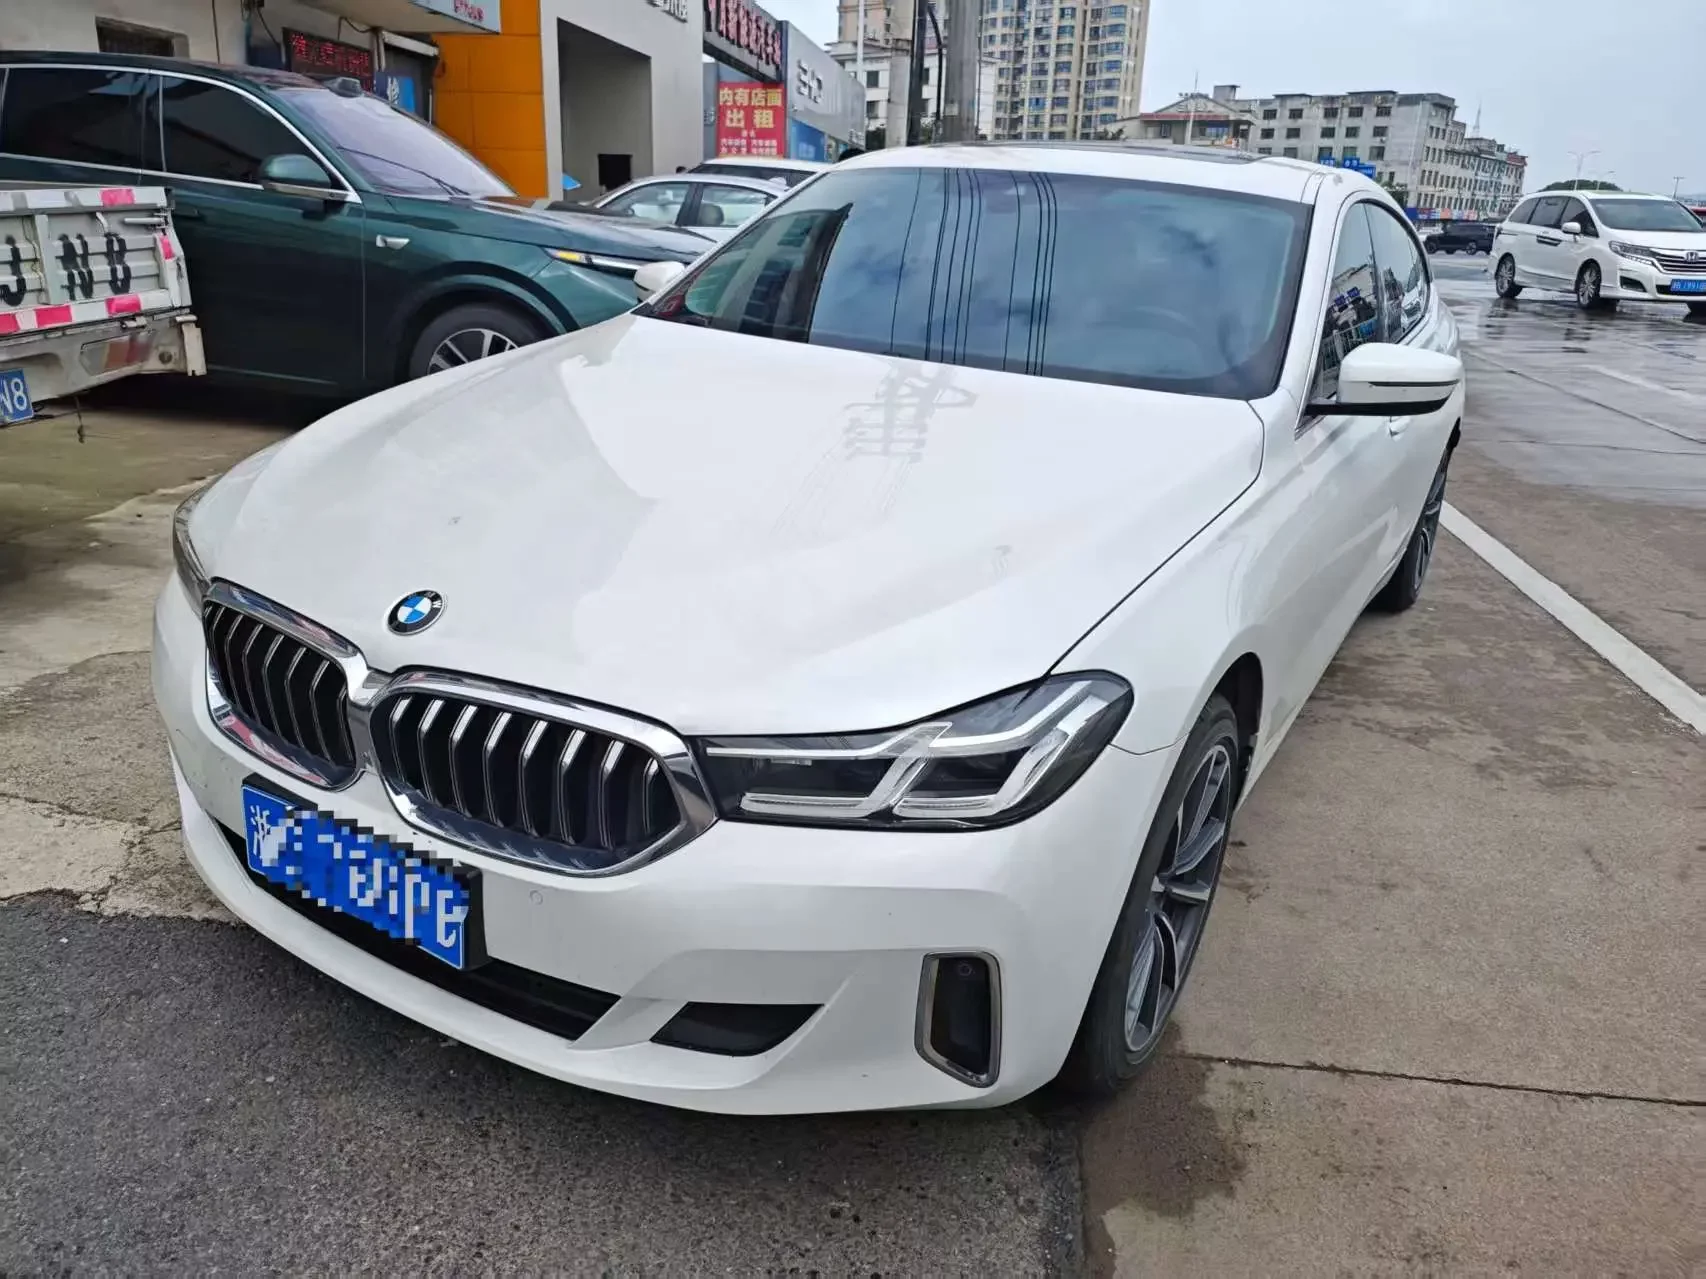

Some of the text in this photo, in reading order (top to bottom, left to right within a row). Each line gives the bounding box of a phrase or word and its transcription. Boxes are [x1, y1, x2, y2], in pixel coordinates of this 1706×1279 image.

[719, 87, 782, 106] 内有店面
[725, 109, 774, 128] 出租
